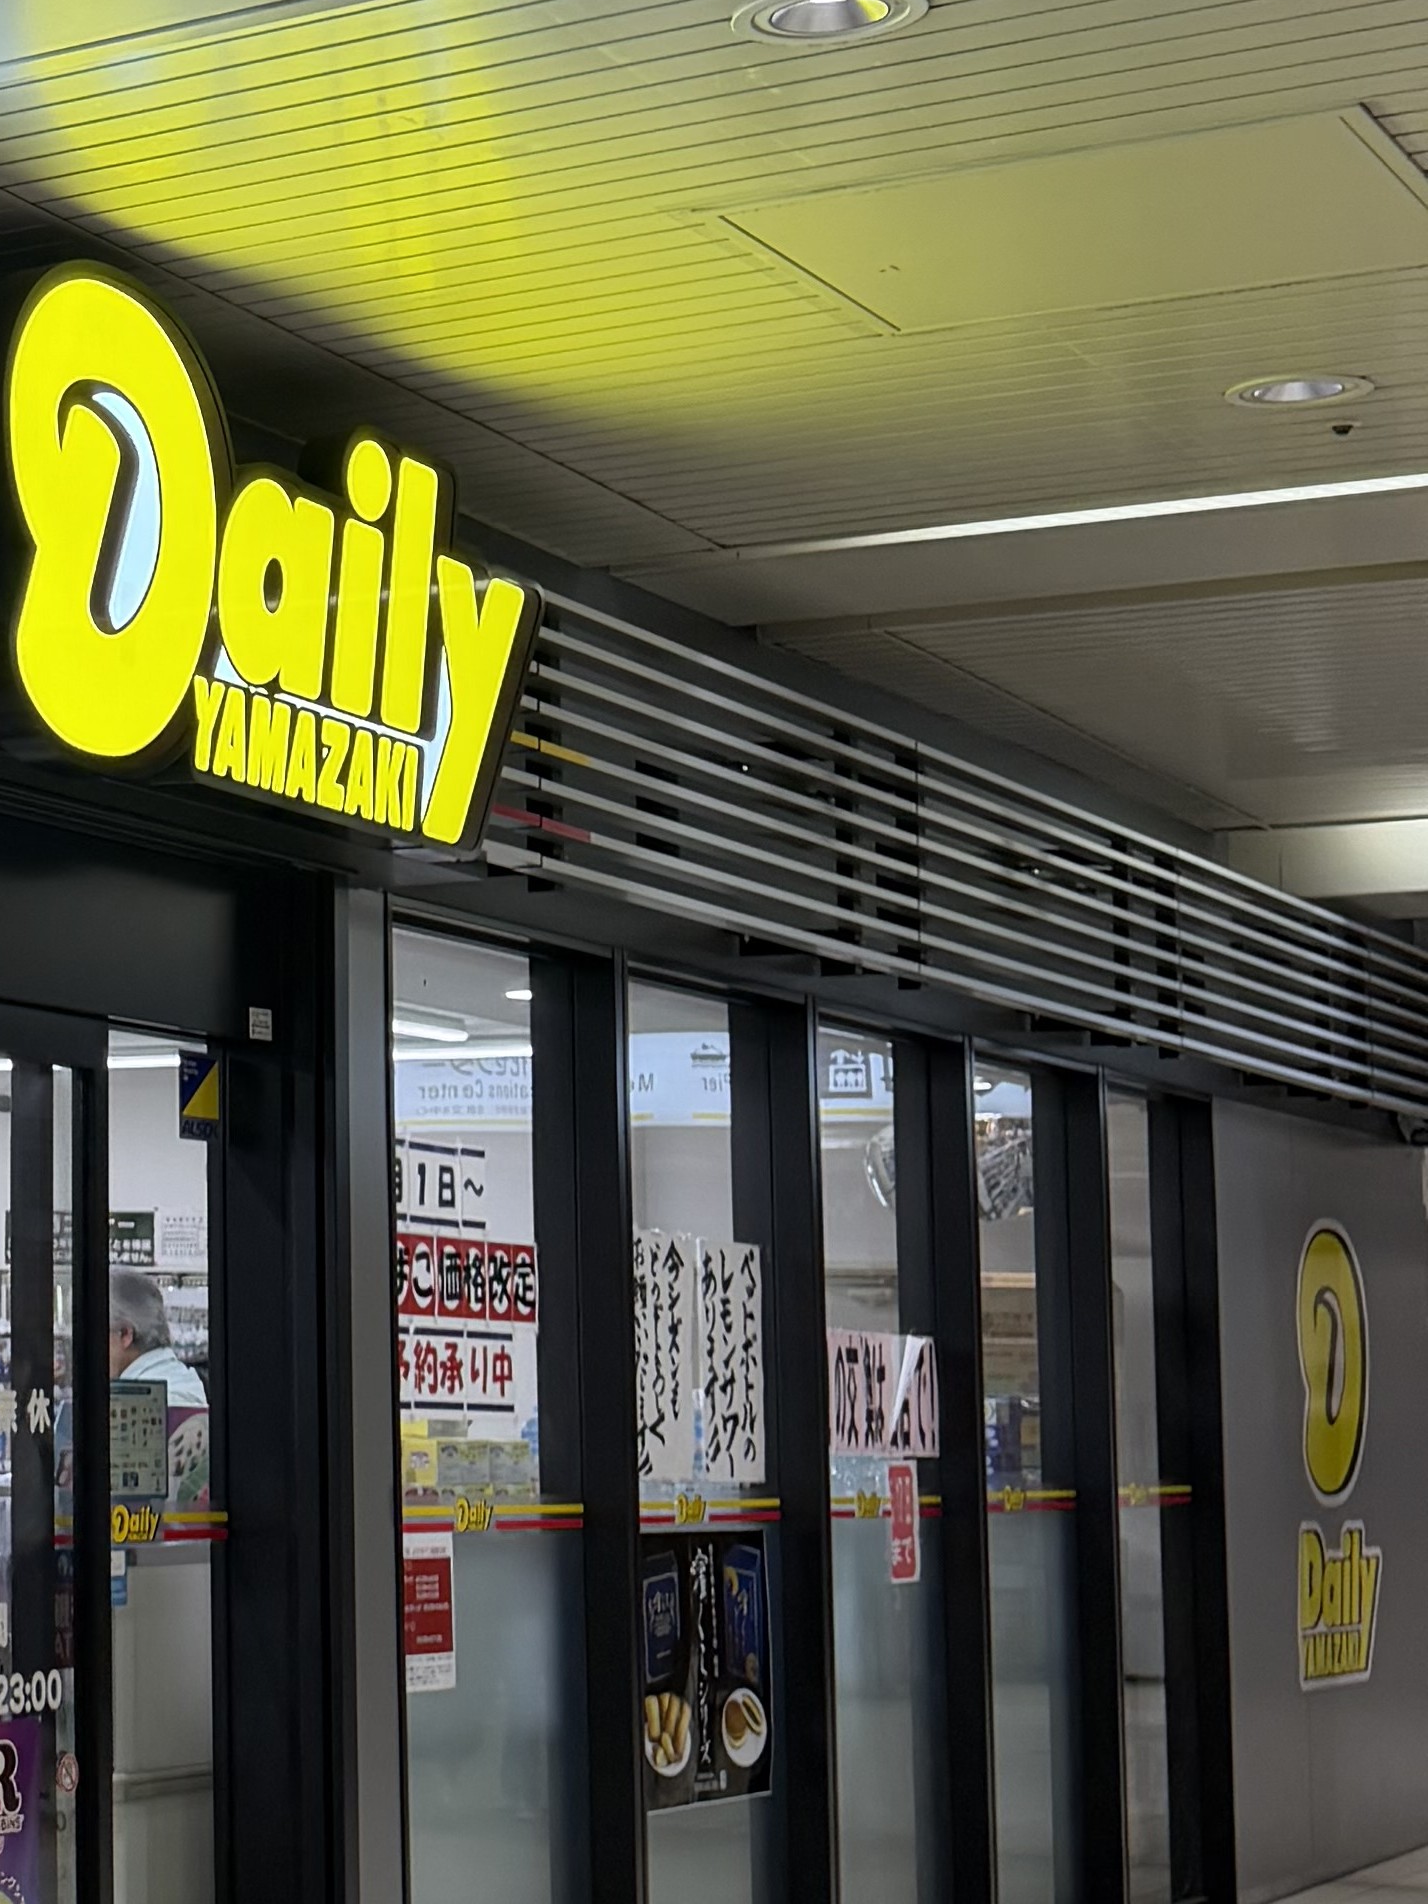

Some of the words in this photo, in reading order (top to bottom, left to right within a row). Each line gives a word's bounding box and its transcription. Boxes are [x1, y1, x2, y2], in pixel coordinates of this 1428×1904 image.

[8, 277, 526, 844] Daily
[195, 674, 418, 832] YAMAZAKI
[112, 1504, 160, 1543] Daily
[1301, 1528, 1380, 1673] Daily
